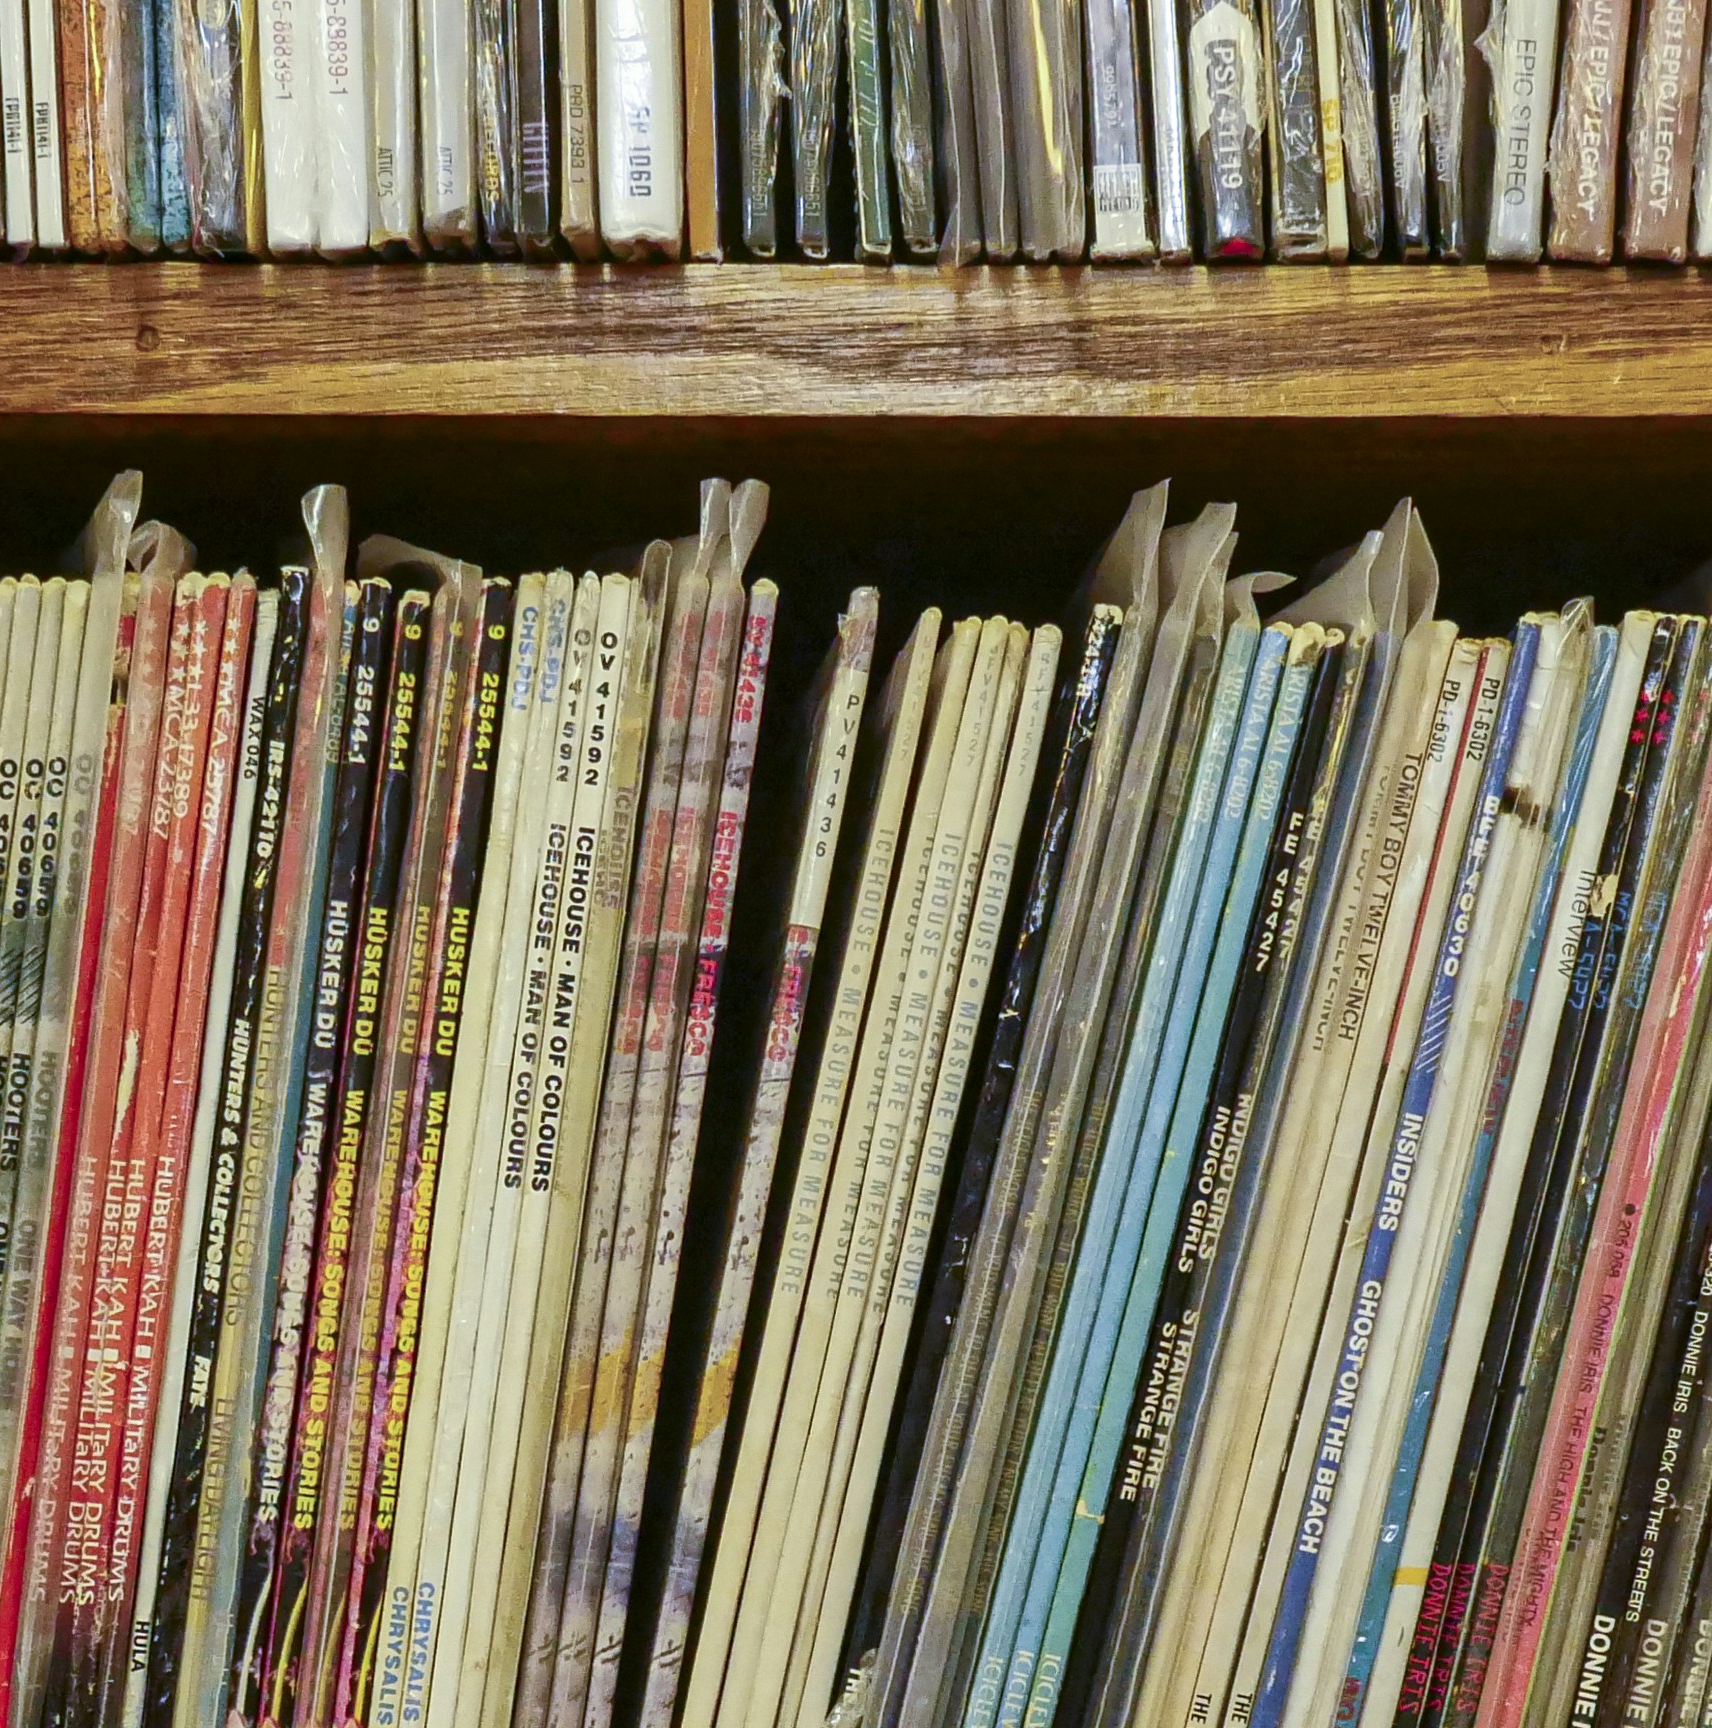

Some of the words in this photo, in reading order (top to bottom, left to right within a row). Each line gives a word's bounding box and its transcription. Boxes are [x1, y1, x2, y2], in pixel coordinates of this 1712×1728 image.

[597, 630, 619, 671] OV
[583, 681, 613, 786] 41592
[1465, 676, 1500, 762] PD-1-6302
[1281, 812, 1304, 856] FE
[1386, 750, 1422, 834] TOMMY
[559, 825, 594, 953] ICEHOUSE
[969, 841, 1013, 967] ICEHOUSE
[1374, 836, 1402, 886] BOY
[356, 907, 388, 1013] HÜSKER
[1253, 866, 1292, 974] 45427
[1337, 889, 1389, 1041] TWELVE-INCH
[351, 1019, 375, 1055] DÜ
[550, 973, 576, 1028] MAN
[221, 1018, 249, 1122] HUNTERS
[545, 1035, 569, 1069] OF
[935, 1000, 978, 1121] MEASURE
[218, 1127, 236, 1147] &
[325, 1089, 363, 1258] WAREHOUSE:
[530, 1073, 564, 1193] COLOURS
[923, 1130, 950, 1179] FOR
[1194, 1105, 1232, 1195] INDIGO
[1377, 1112, 1422, 1233] INSIDERS
[144, 1155, 173, 1261] HUBERT
[201, 1152, 233, 1293] COLLECTORS
[894, 1187, 937, 1309] MEASURE
[1175, 1197, 1210, 1275] GIRLS
[136, 1273, 160, 1337] KAH
[314, 1262, 342, 1352] SONGS
[1344, 1278, 1381, 1366] GHOST
[307, 1358, 331, 1412] AND
[1132, 1320, 1178, 1441] STRANGE
[1333, 1369, 1360, 1410] ON
[293, 1417, 324, 1529] STORIES
[1118, 1442, 1149, 1503] FIRE
[1320, 1412, 1350, 1464] THE
[106, 1498, 135, 1602] DRUMS
[1297, 1466, 1336, 1554] BEACH
[128, 1619, 150, 1672] HULA
[1571, 1613, 1616, 1717] DONNIE
